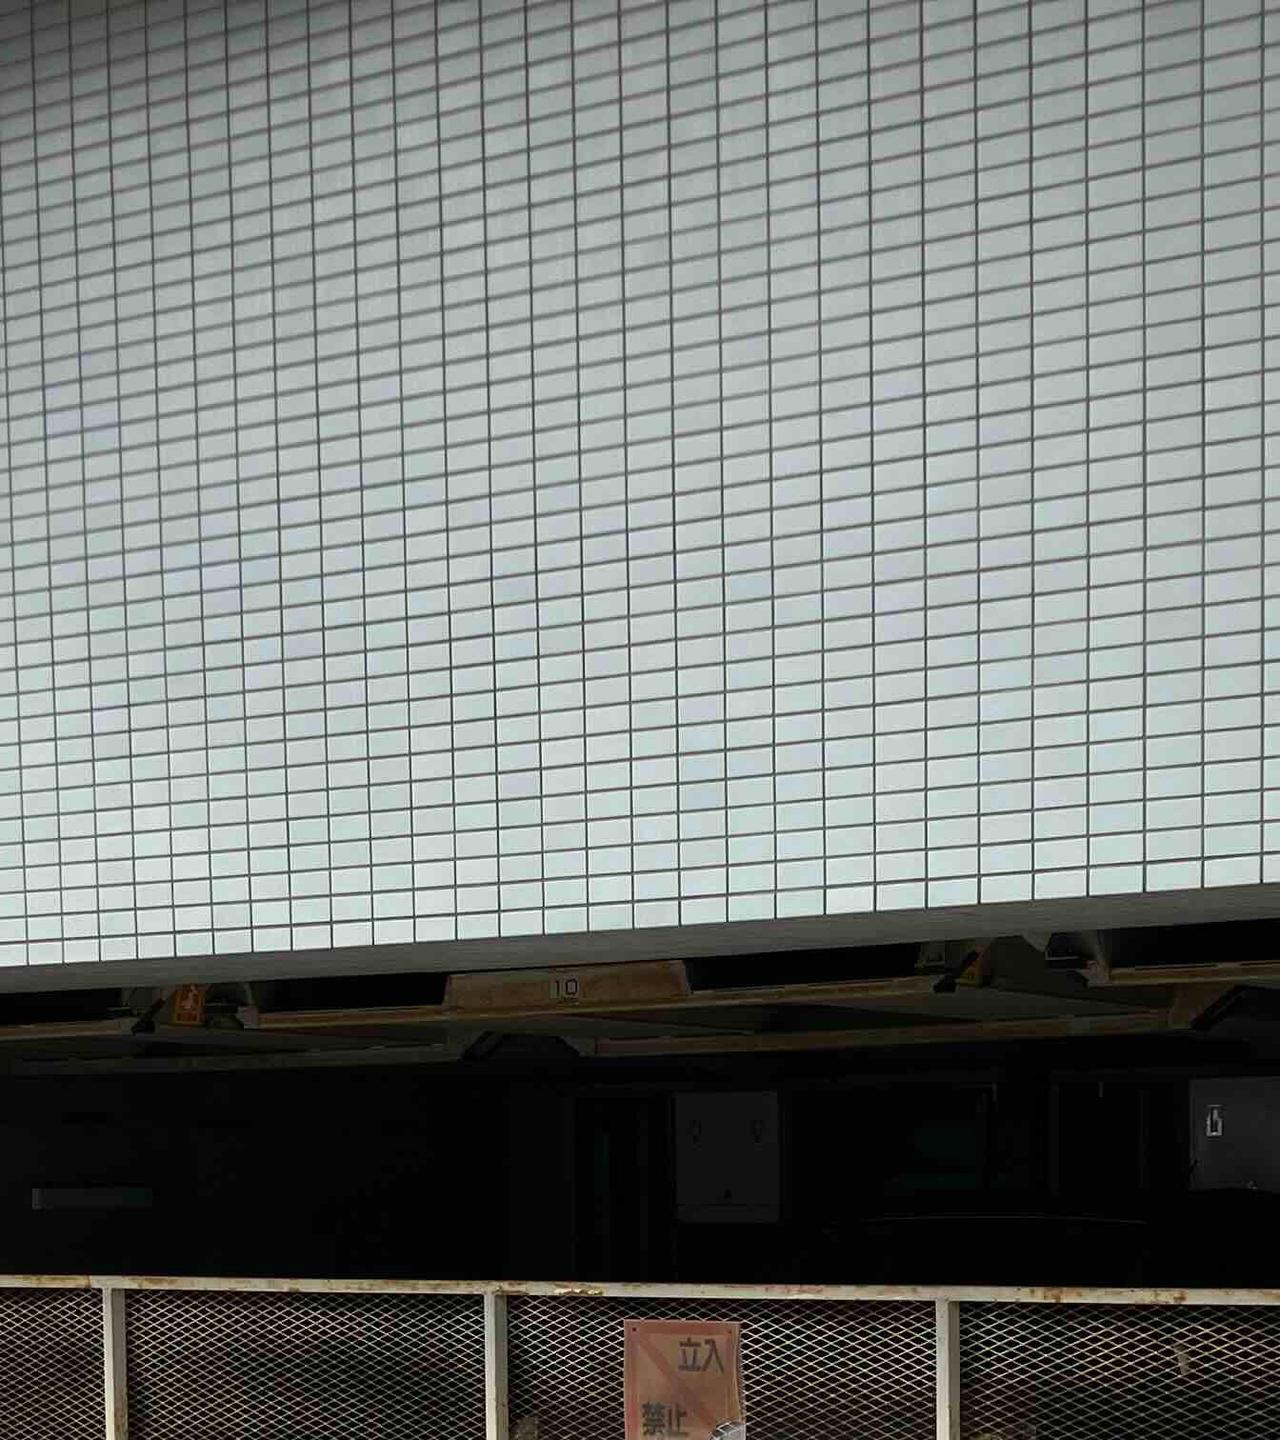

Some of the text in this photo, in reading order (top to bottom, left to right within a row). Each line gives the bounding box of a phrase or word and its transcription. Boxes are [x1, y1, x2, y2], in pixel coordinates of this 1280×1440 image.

[555, 978, 578, 995] 10
[678, 1337, 724, 1373] 立入
[642, 1401, 689, 1436] 禁止
